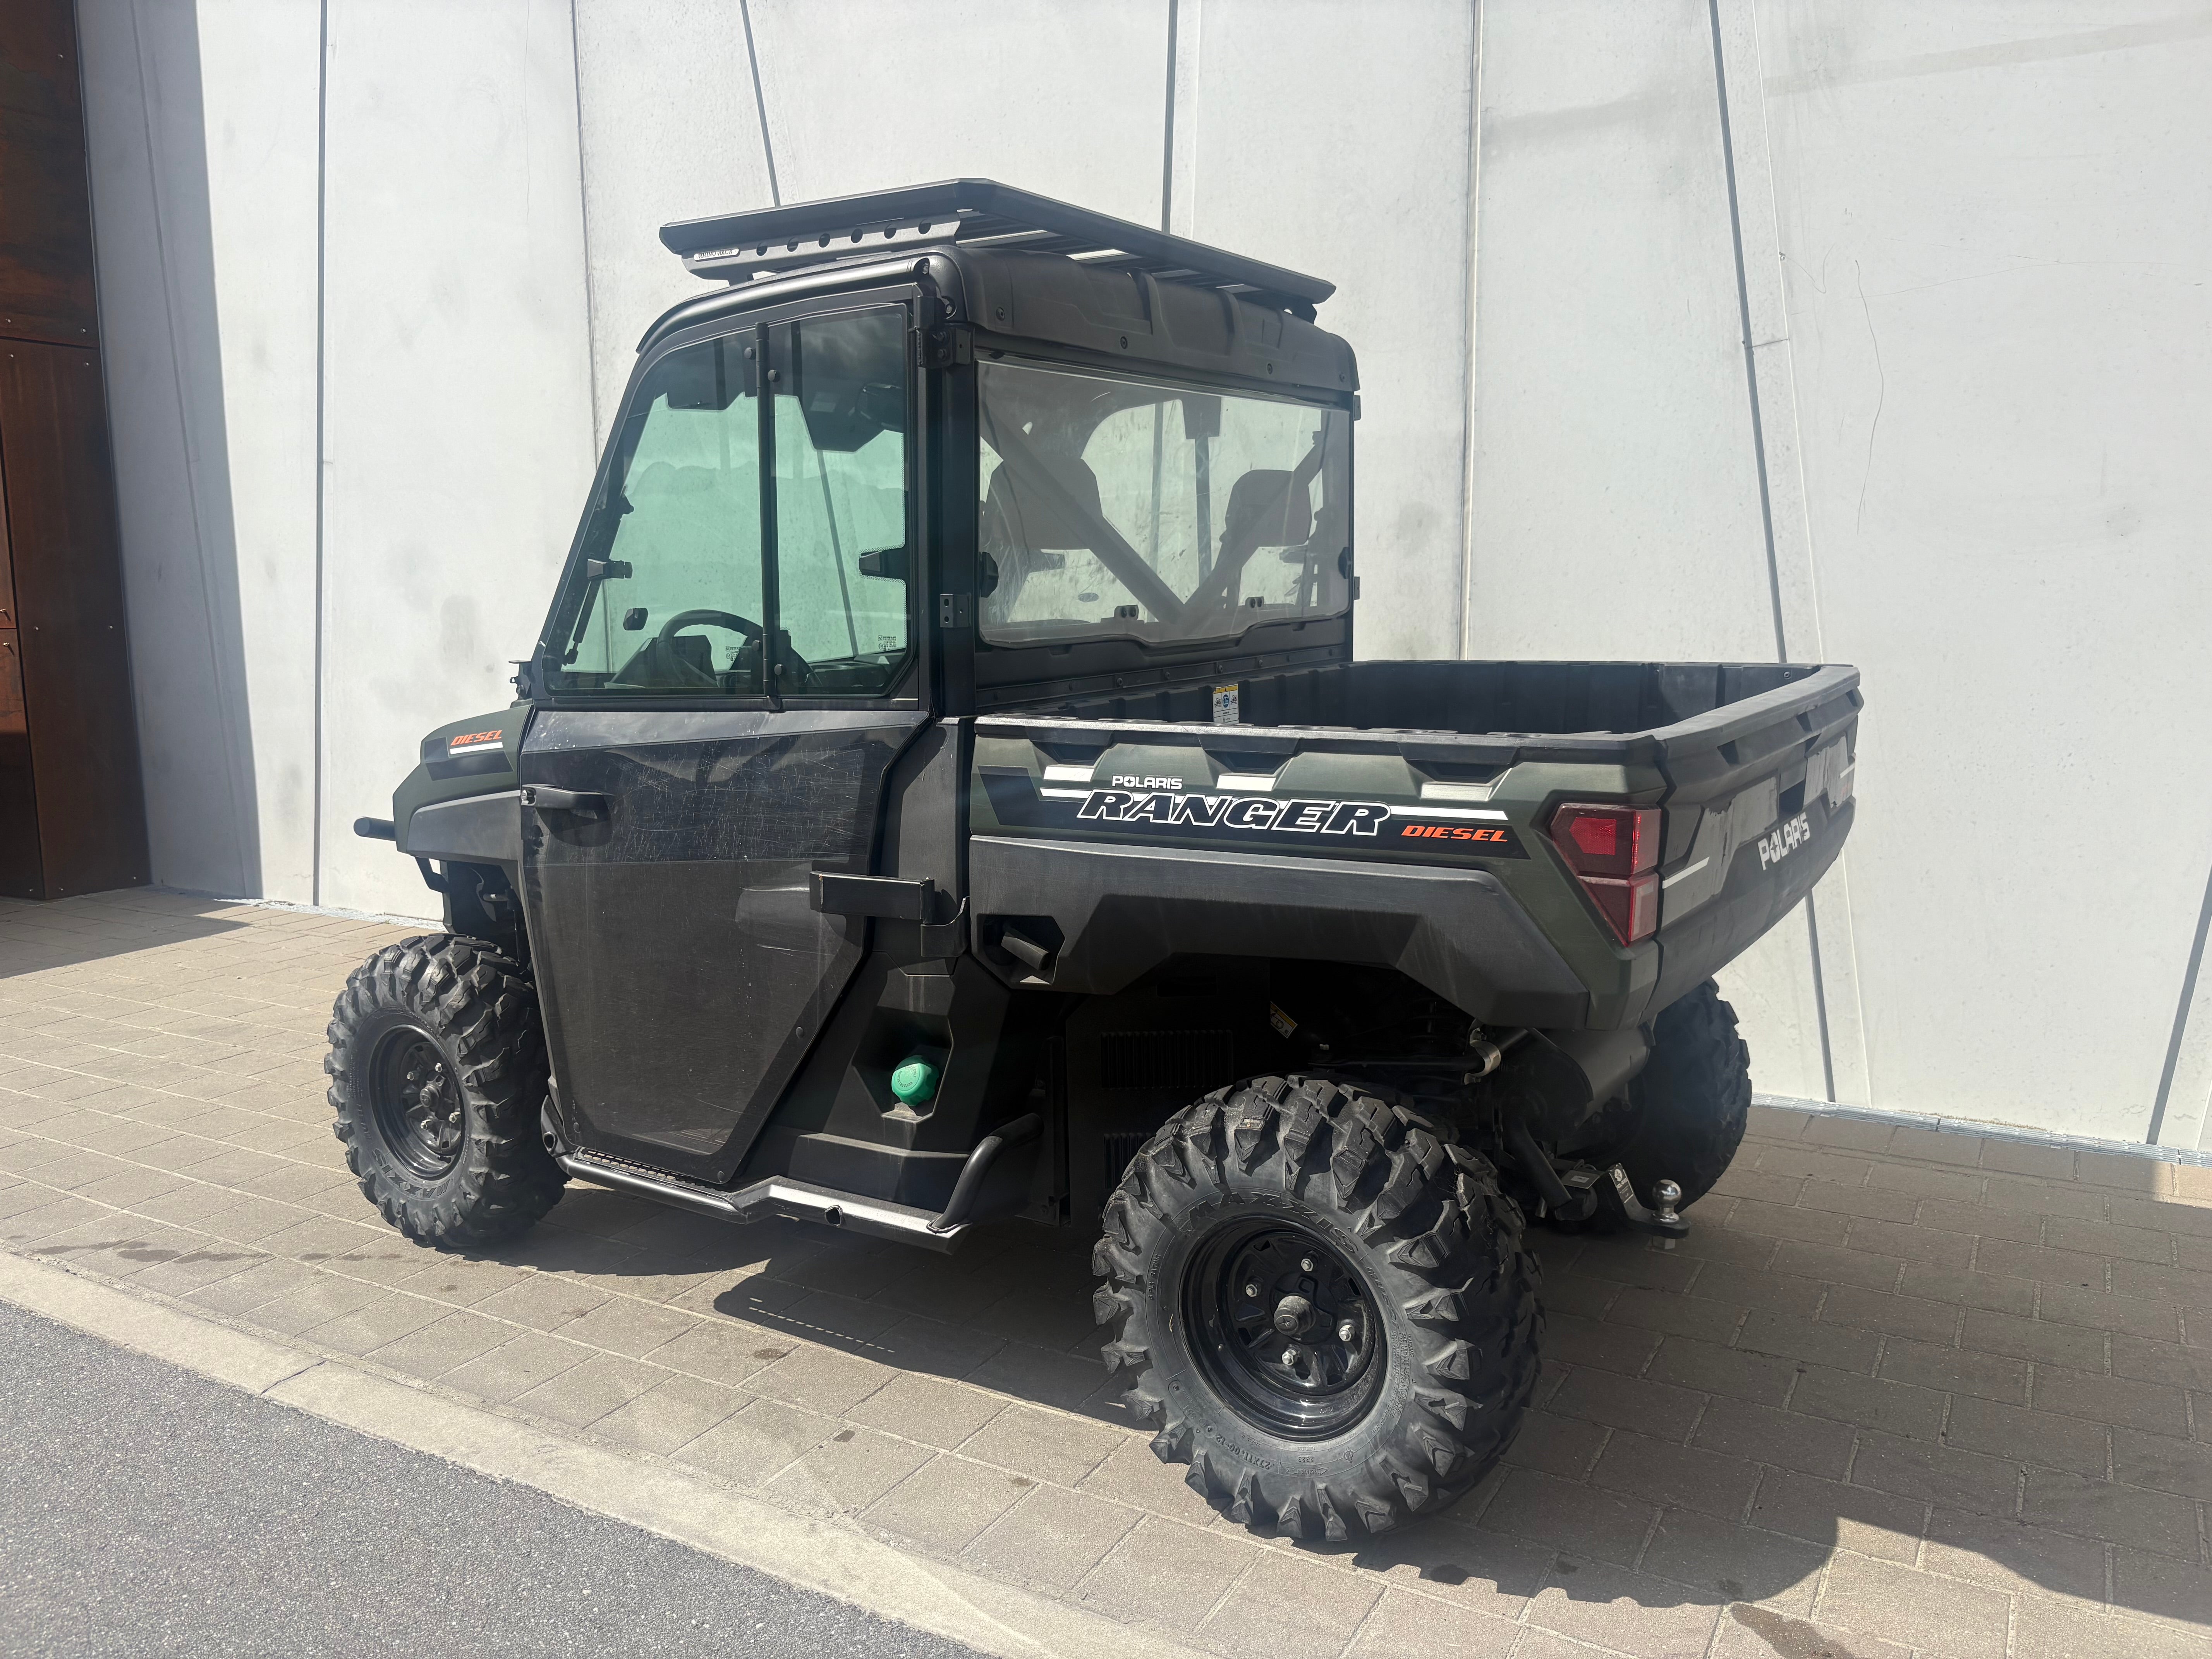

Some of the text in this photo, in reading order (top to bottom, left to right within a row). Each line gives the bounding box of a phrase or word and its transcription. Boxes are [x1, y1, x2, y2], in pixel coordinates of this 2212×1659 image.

[450, 730, 502, 746] DIESEL
[1111, 775, 1182, 790] POLARIS
[1077, 789, 1392, 836] RANGER
[1401, 824, 1508, 843] DIESEL
[1758, 812, 1810, 871] POLARIS
[372, 1149, 450, 1199] MAXXIS
[1188, 1191, 1358, 1254] MAXXIS
[1150, 1253, 1161, 1277] RATING
[1215, 1433, 1271, 1470] 27X11.00-12
